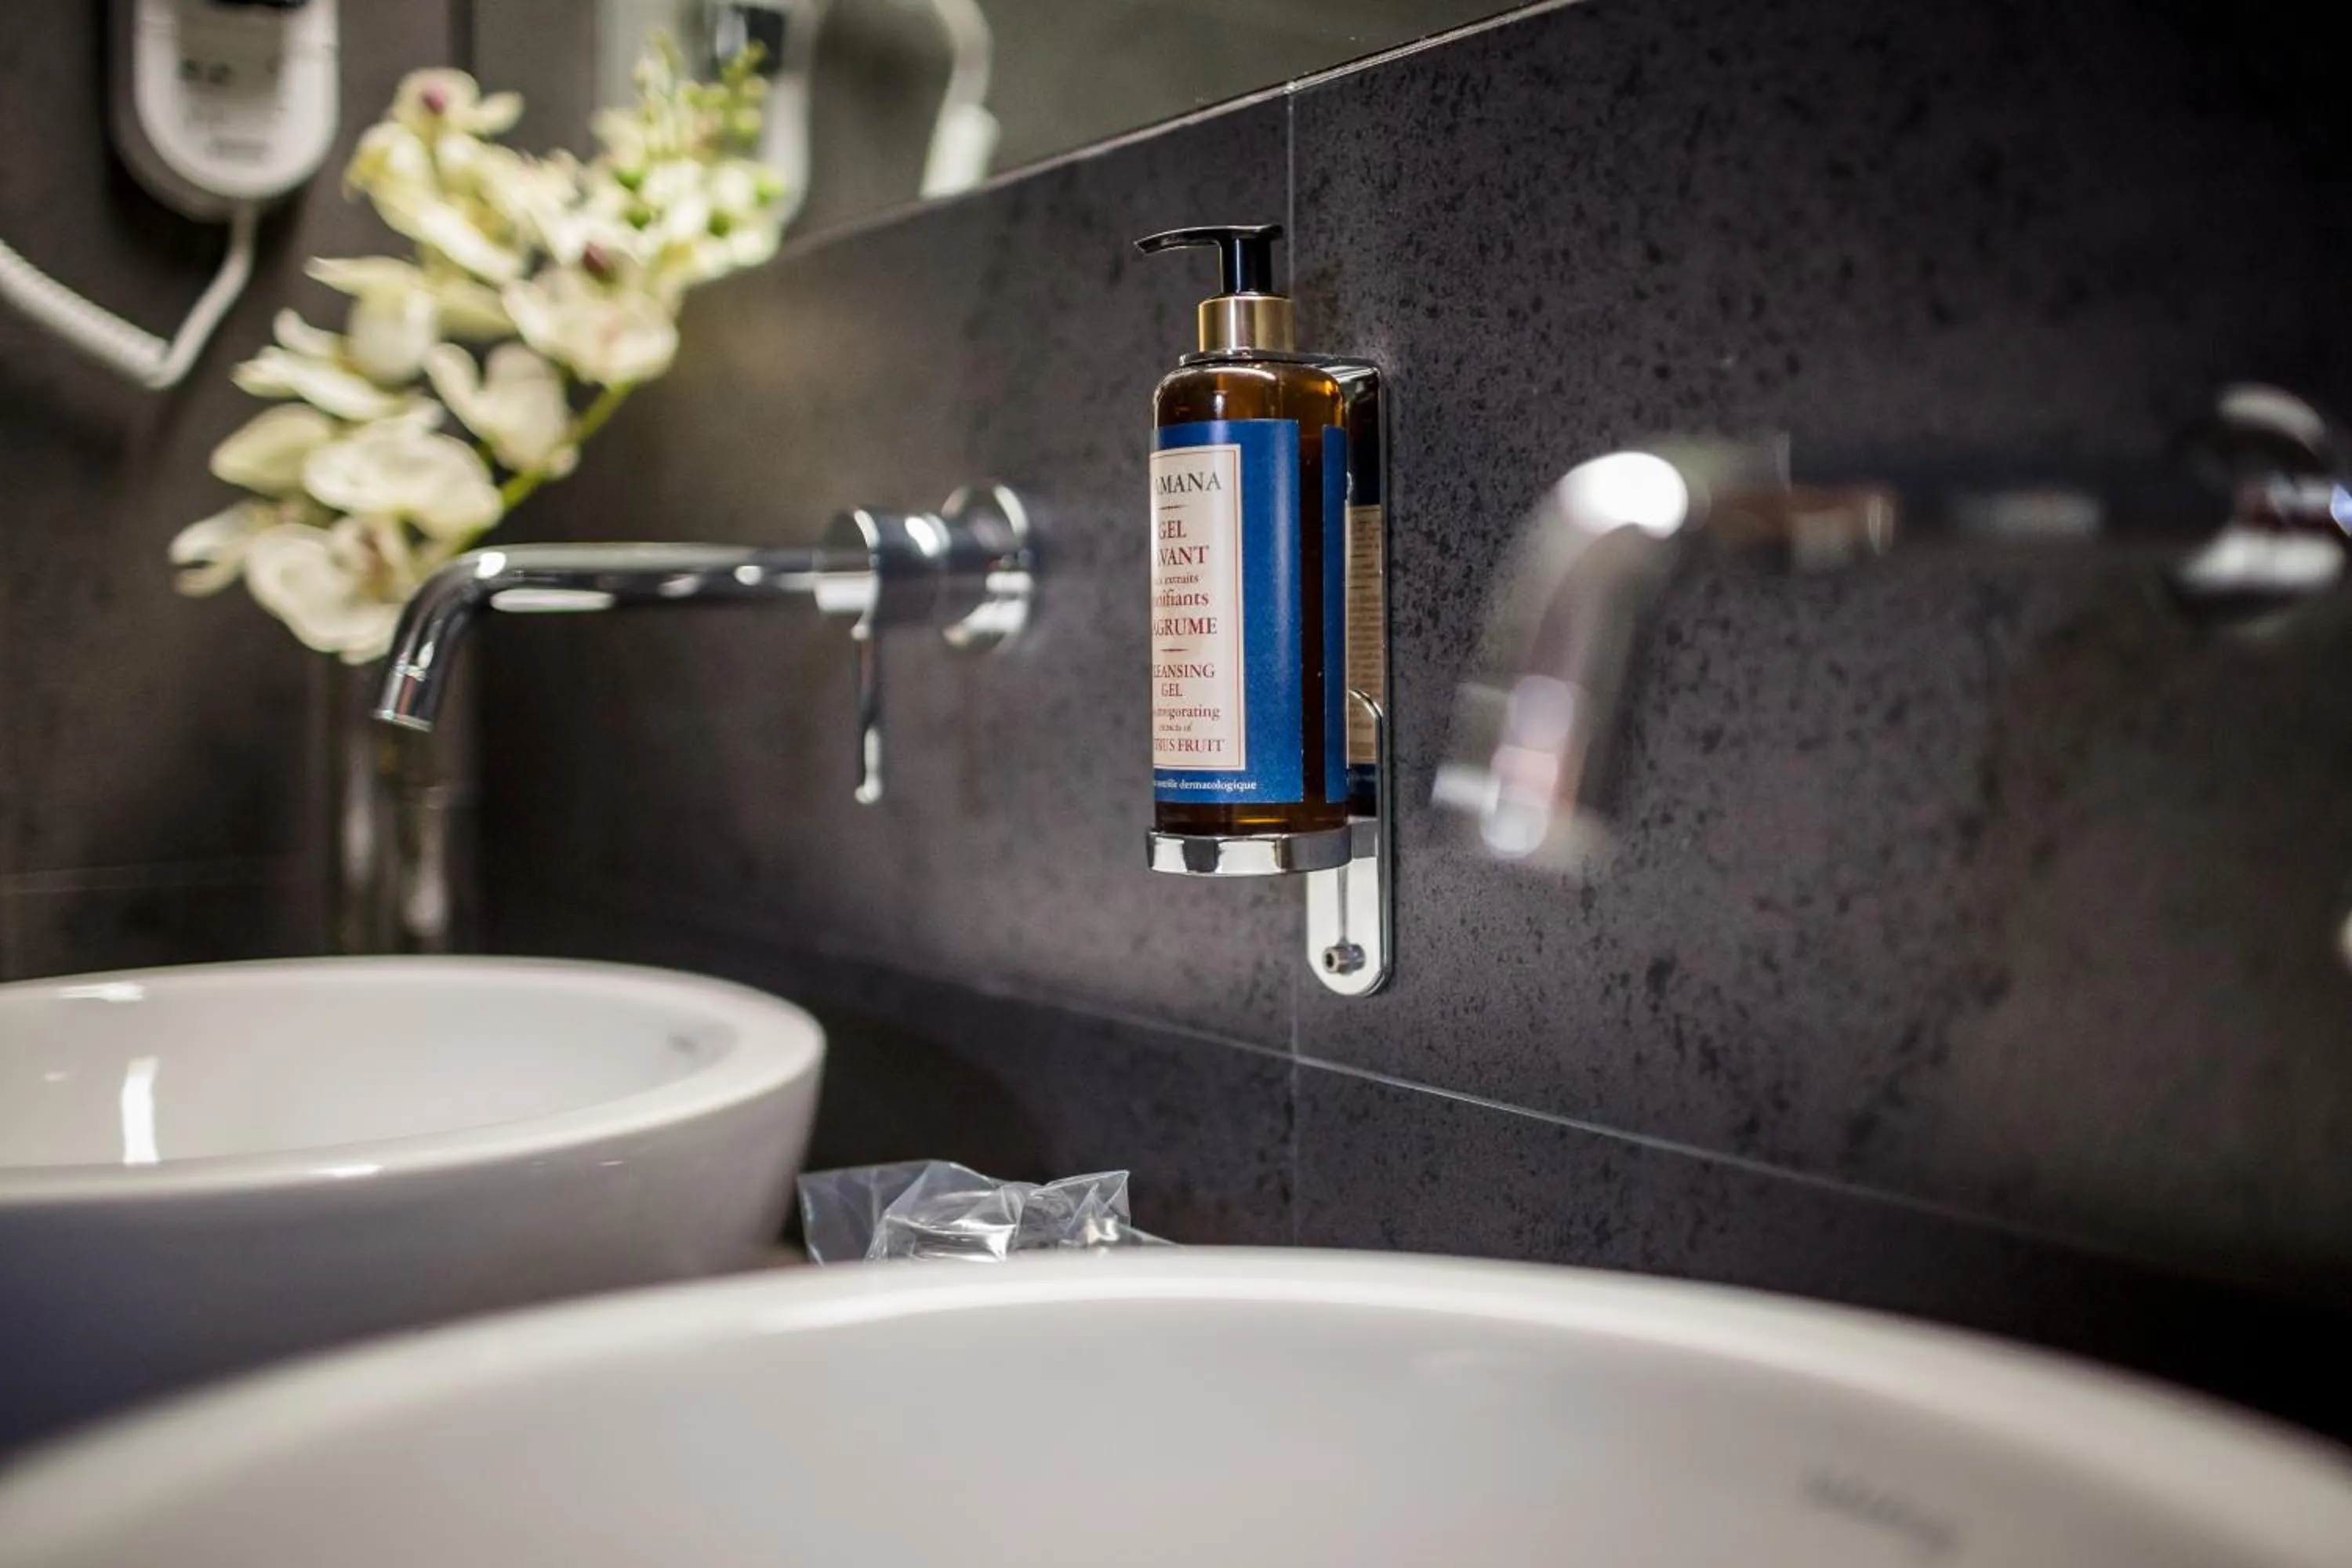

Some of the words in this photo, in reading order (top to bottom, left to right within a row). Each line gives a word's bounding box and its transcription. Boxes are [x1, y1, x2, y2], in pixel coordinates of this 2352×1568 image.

[1159, 520, 1187, 539] GEL
[1161, 683, 1183, 697] GEL
[1178, 739, 1225, 752] FRUIT
